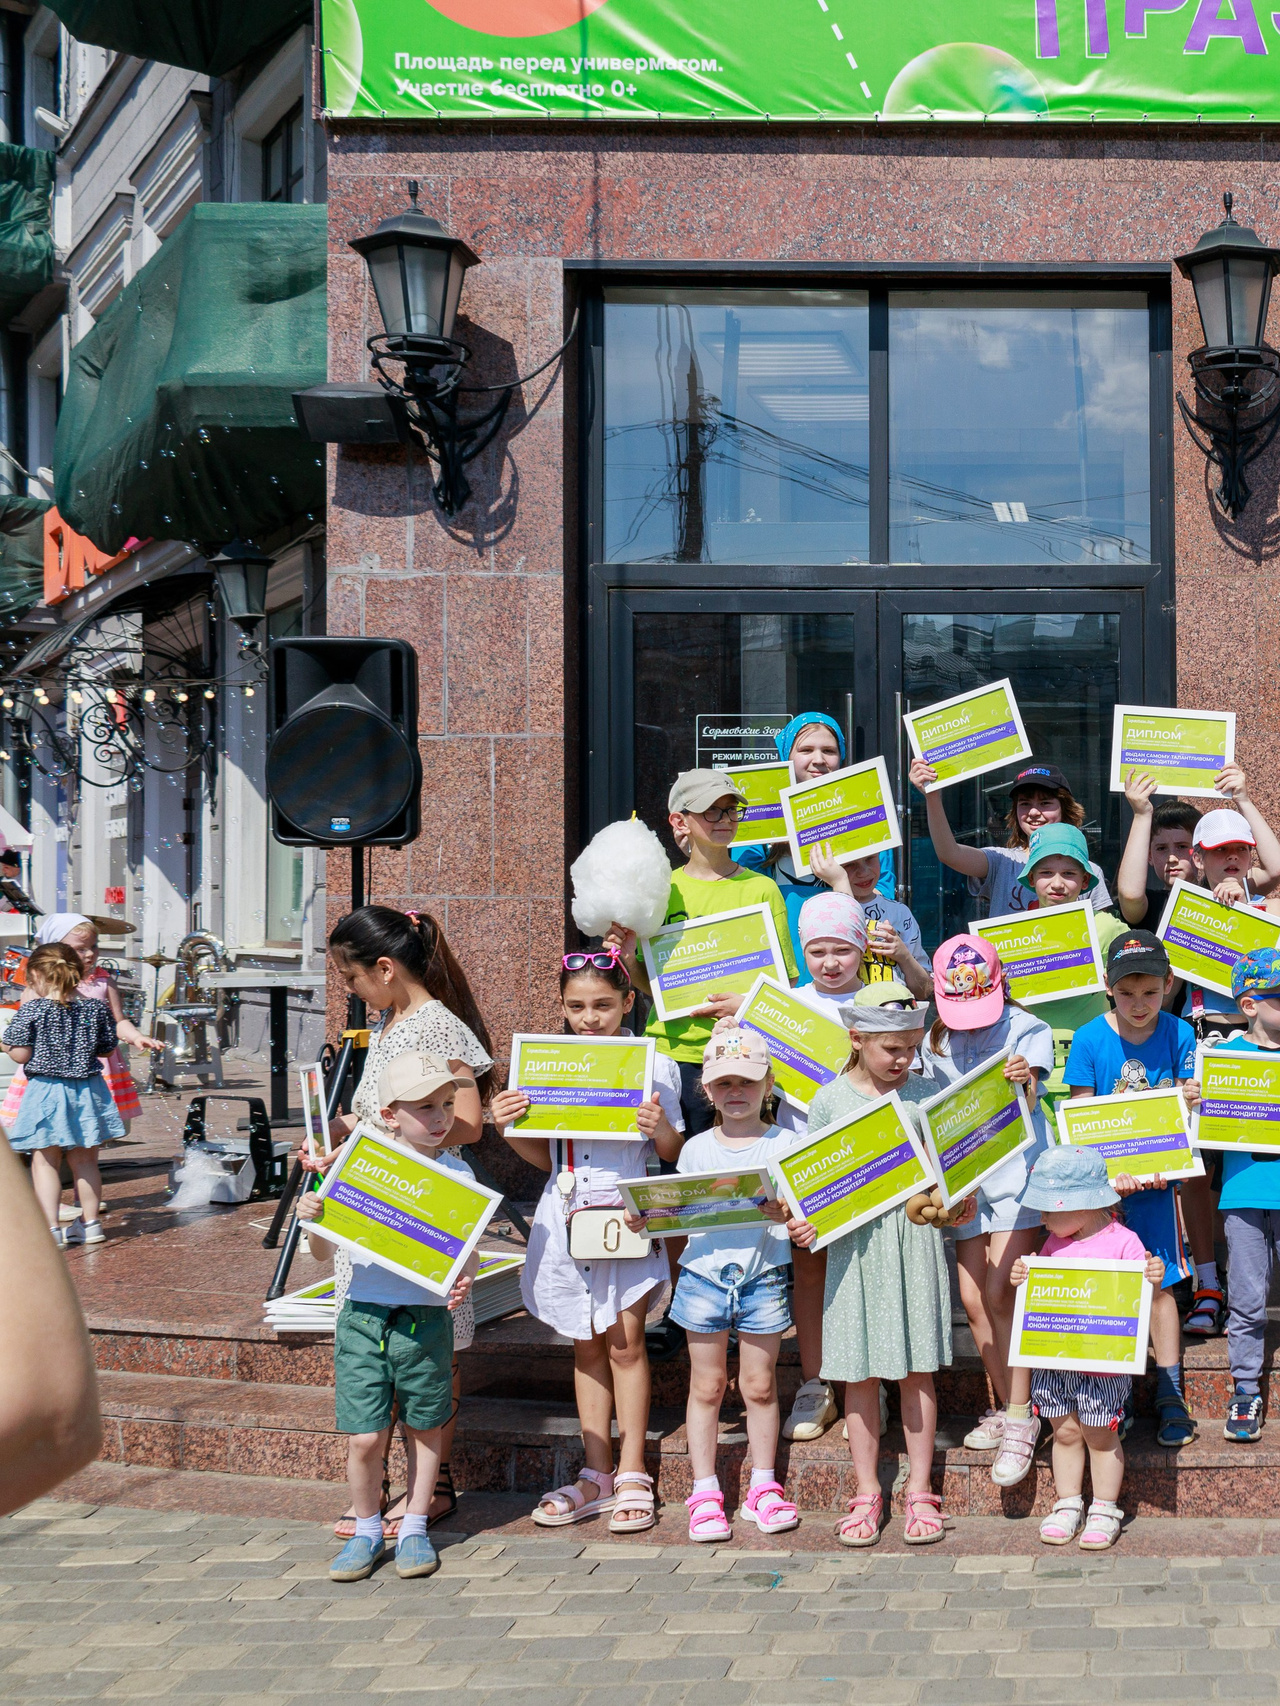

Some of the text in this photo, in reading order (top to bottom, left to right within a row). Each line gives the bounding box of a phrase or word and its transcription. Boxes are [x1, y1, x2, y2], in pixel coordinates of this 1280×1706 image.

[395, 53, 724, 77] Площадь перед универмагом.
[395, 79, 637, 98] Участие бесплатно 0+
[702, 726, 784, 740] Сормовские Зор
[920, 714, 970, 740] ДИПЛОМ
[1126, 728, 1181, 740] ДИПЛОМ
[1017, 768, 1050, 780] PRINCESS
[795, 795, 842, 819] ДИПЛОМ
[1177, 905, 1233, 934] ДИПЛОМ
[995, 933, 1042, 951] ИПЛОМ
[1168, 934, 1222, 959] ЮНОМУ КОНДИТЕРУ
[1170, 929, 1190, 940] ВЫДАН
[1190, 937, 1214, 950] САМОМУ
[657, 938, 717, 962] ДИПЛОМ
[662, 972, 684, 982] ВЫДАН
[685, 966, 711, 977] САМОМУ
[1010, 960, 1035, 970] САМОМУ
[1013, 964, 1047, 975] КОНДИТЕРУ
[663, 968, 724, 988] ЮНОМУ КОНДИТЕРУ
[754, 1000, 808, 1037] ДИПЛОМ
[524, 1060, 590, 1073] ДИПЛОМ
[1207, 1074, 1270, 1089] ДИПЛОМ
[934, 1098, 980, 1139] ДИПЛОМ
[1070, 1116, 1132, 1133] ДИПЛОМ
[1099, 1142, 1126, 1150] САМОМУ
[1102, 1146, 1139, 1156] КОНДИТЕРУ
[790, 1143, 854, 1186] ДИПЛОМ
[351, 1156, 424, 1200] ДИПЛОМ
[803, 1149, 900, 1207] ВЫДАН САМОМУ ТАЛАНТЛИВОМУ
[639, 1188, 706, 1202] ДИПЛОМ
[806, 1175, 867, 1213] ЮНОМУ КОНДИТЕРУ
[333, 1191, 404, 1229] ЮНОМУ КОНДИТЕРУ
[337, 1185, 450, 1244] ВЫДАН САМОМУ ТАЛАНТЛИВОМУ
[1030, 1286, 1091, 1299] ДИПЛОМ
[1051, 1323, 1087, 1331] КОНДИТЕРУ
[1077, 1318, 1127, 1326] ТАЛАНТЛИВОМУ
